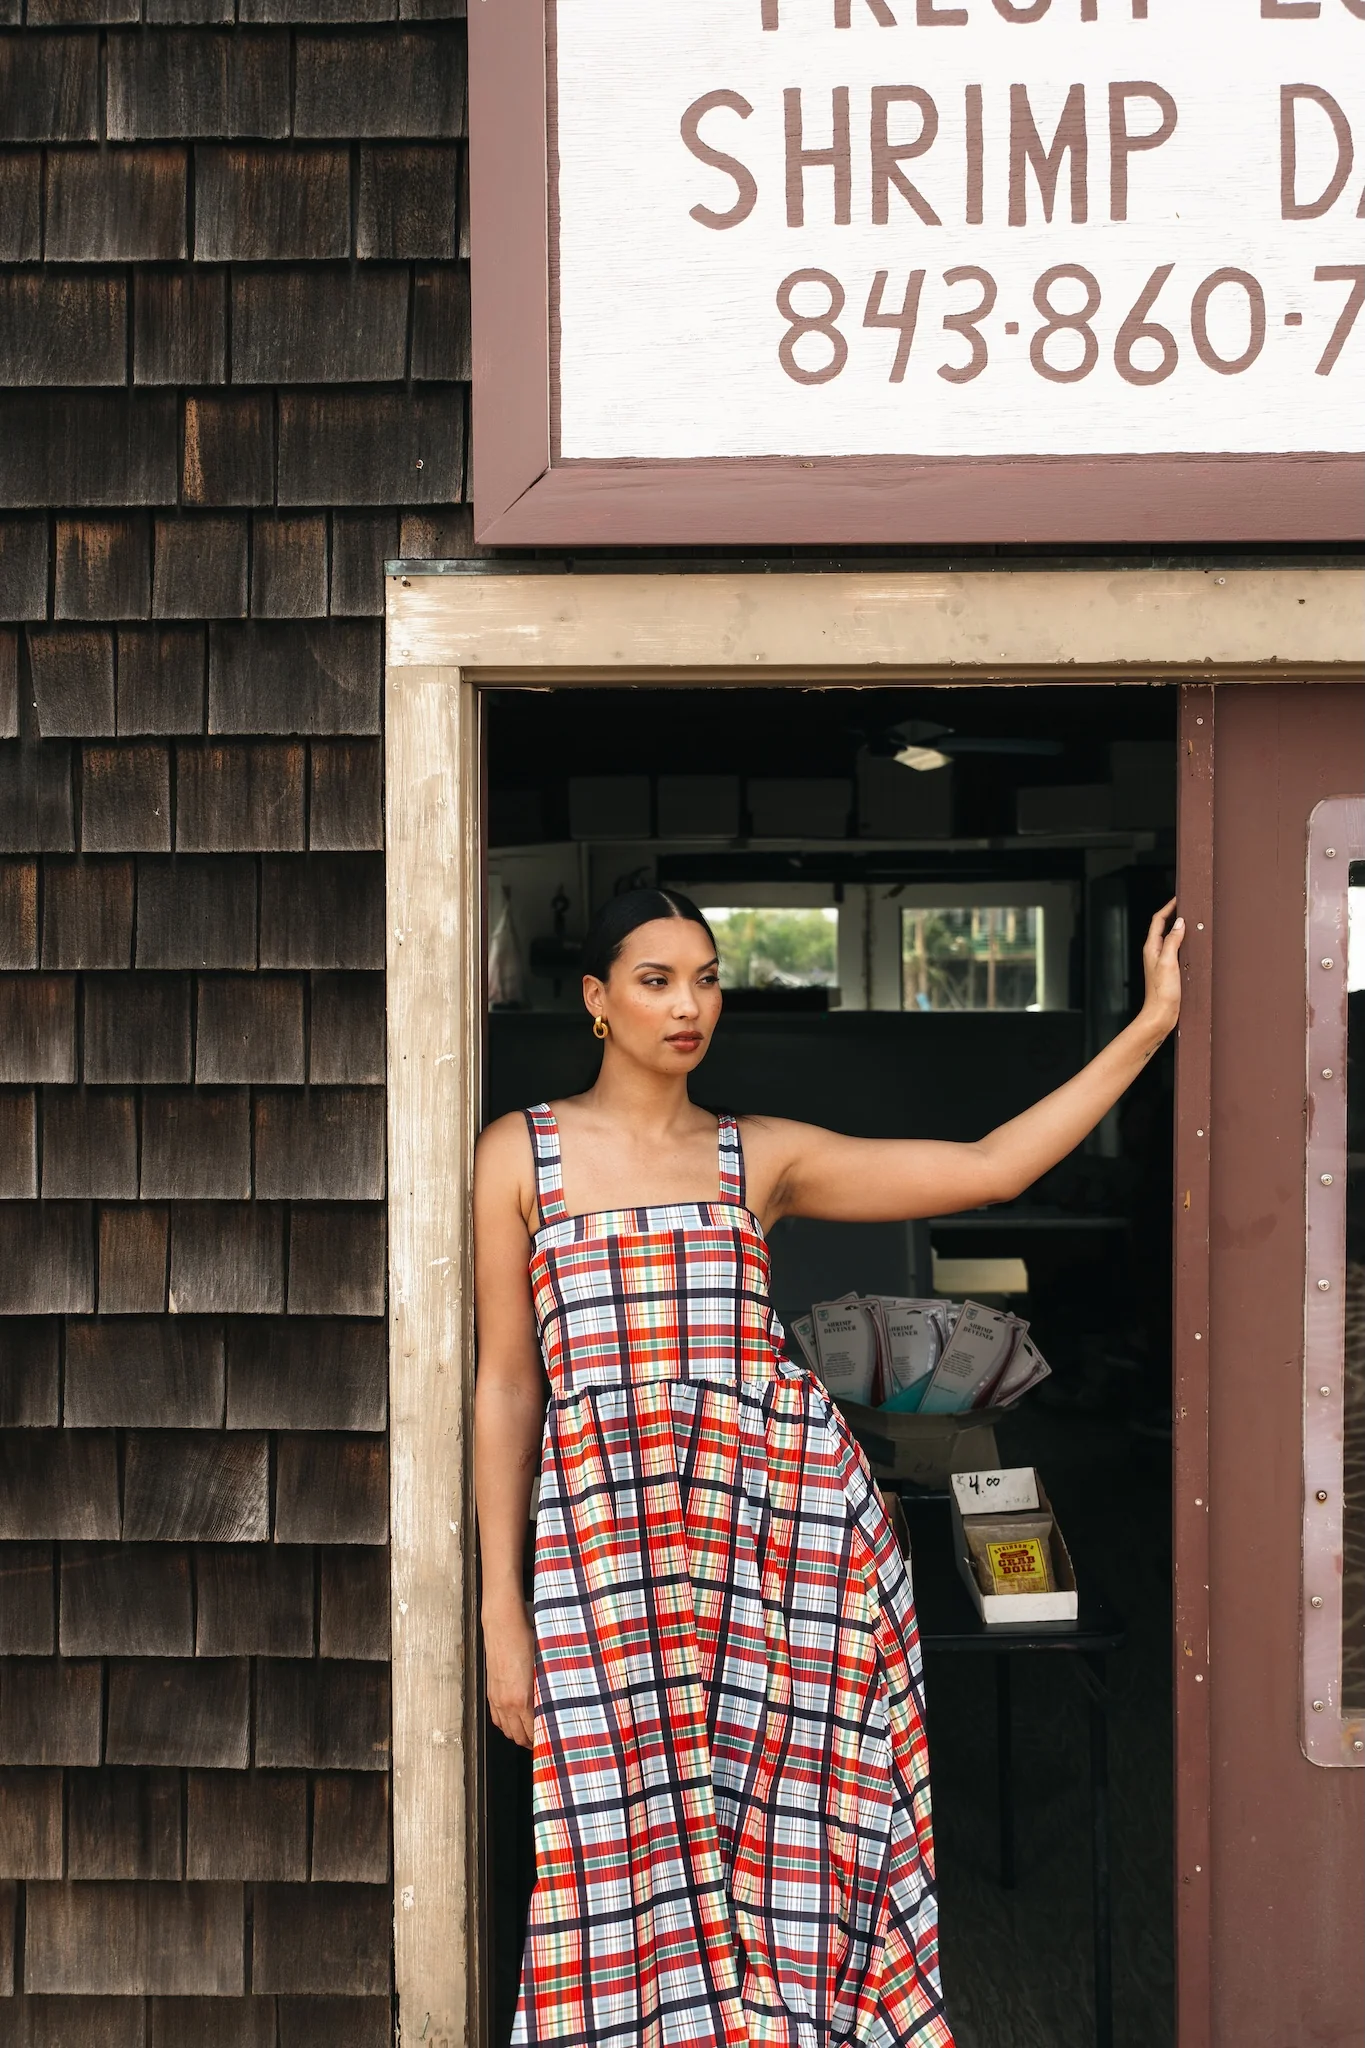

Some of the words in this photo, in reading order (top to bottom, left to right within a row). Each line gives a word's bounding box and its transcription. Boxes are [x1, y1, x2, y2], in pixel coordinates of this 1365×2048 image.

[680, 81, 1178, 230] SHRIMP
[1280, 83, 1365, 220] D
[823, 1325, 857, 1334] DEVEINER
[827, 1320, 852, 1328] SHRIMP
[969, 1322, 993, 1334] SHRIMP
[963, 1327, 995, 1341] DEVEINER
[998, 1556, 1035, 1567] CRAB
[1002, 1564, 1035, 1574] BOIL
